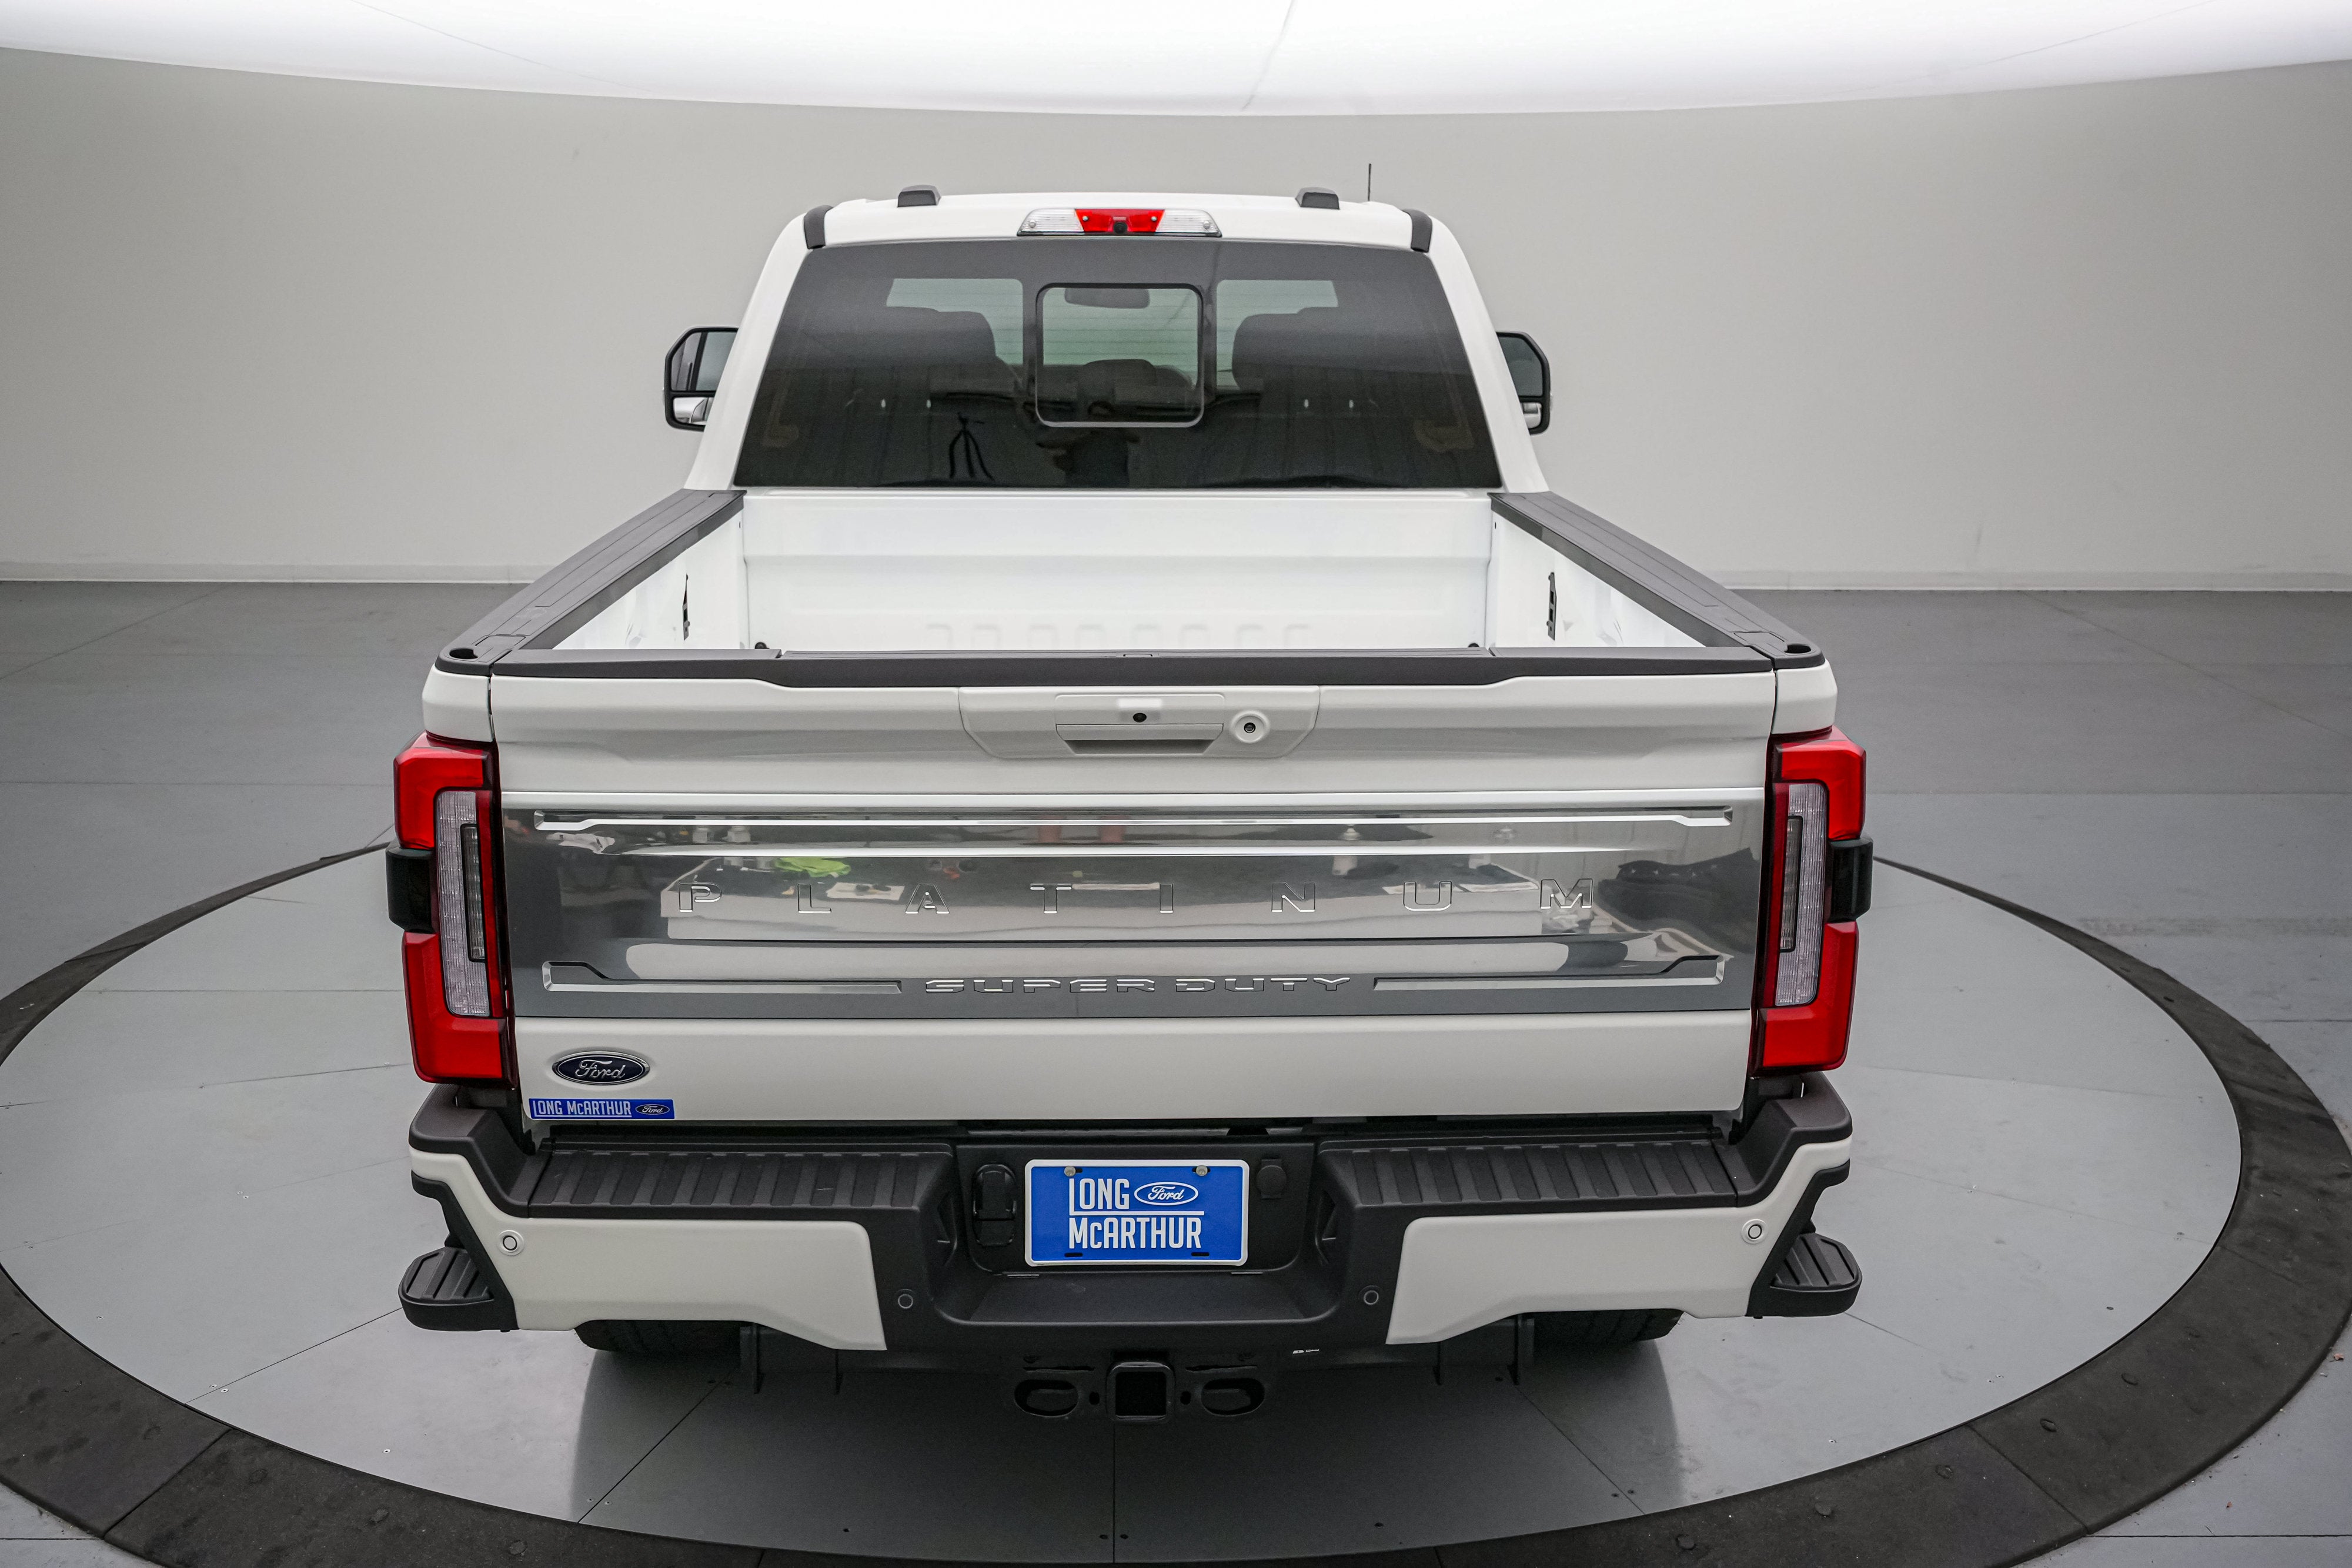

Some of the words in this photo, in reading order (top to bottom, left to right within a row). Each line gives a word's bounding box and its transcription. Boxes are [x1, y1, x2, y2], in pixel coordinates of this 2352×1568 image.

[678, 878, 1594, 914] PLATINUM
[925, 978, 1155, 994] SUPER
[1175, 977, 1351, 992] DUTY
[574, 1059, 626, 1079] Ford
[532, 1100, 563, 1116] LONG
[567, 1101, 632, 1115] McARTHUR
[642, 1105, 663, 1114] Ford
[1069, 1178, 1130, 1215] LONG
[1147, 1185, 1185, 1201] Ford
[1068, 1217, 1202, 1249] McARTHUR
